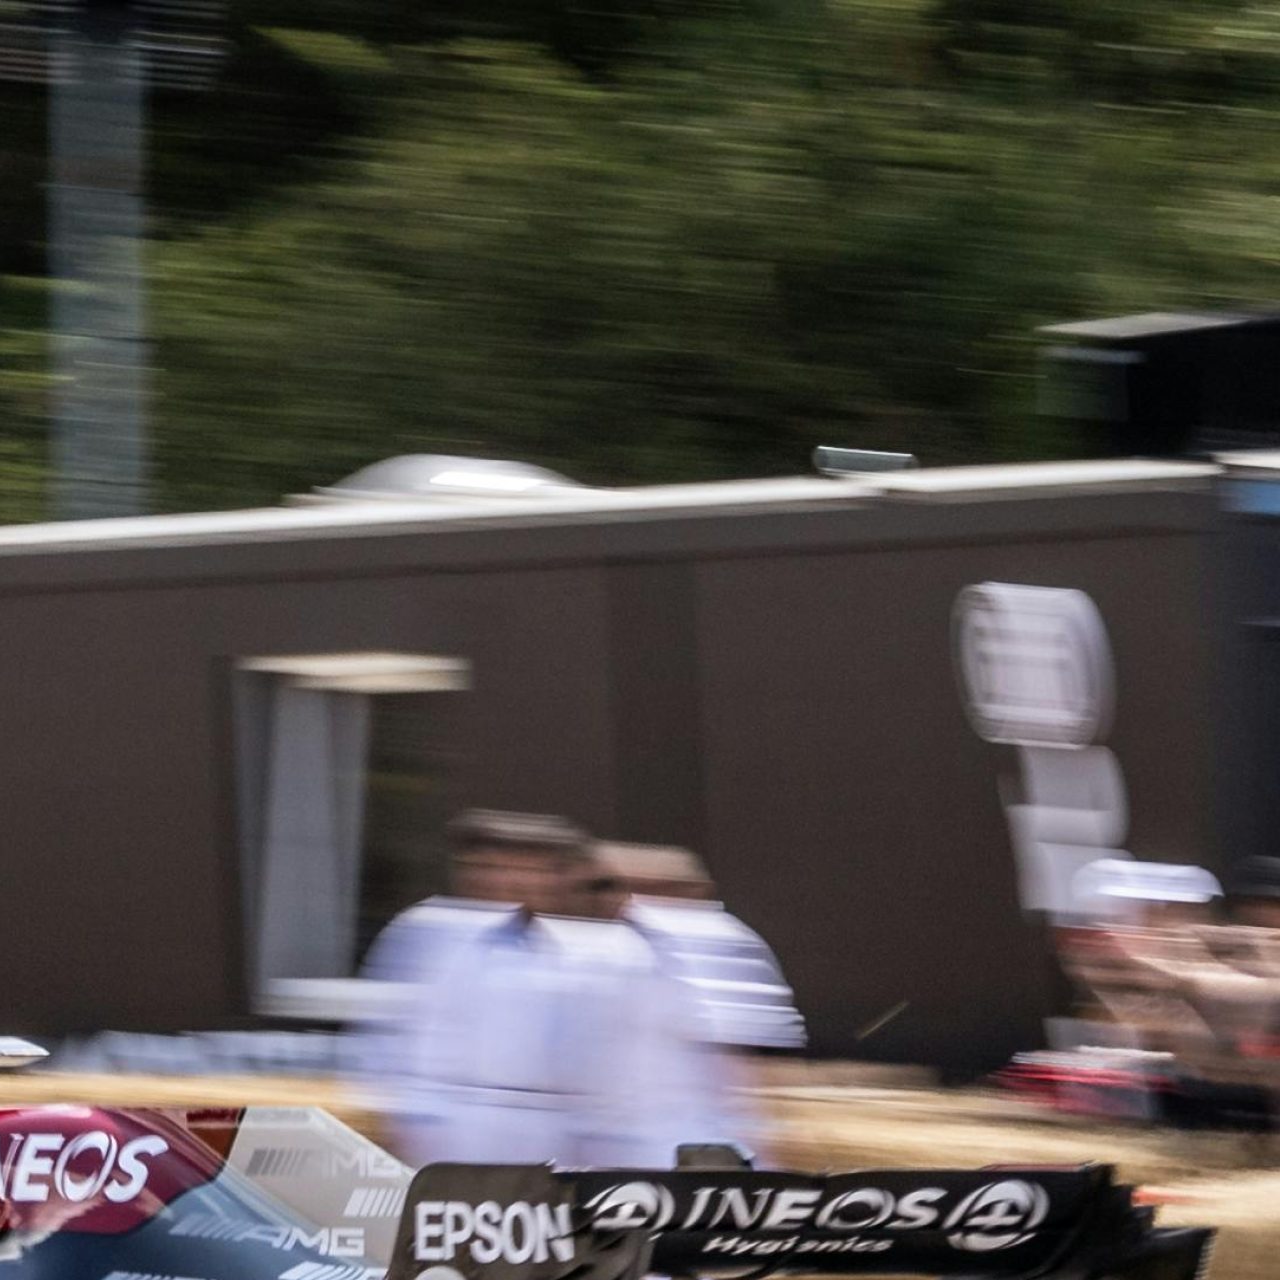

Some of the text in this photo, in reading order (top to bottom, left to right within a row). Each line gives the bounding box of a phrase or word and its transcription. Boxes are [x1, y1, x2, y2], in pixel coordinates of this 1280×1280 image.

[415, 1200, 575, 1264] EPSON
[681, 1186, 950, 1232] INEOS
[233, 1224, 366, 1258] AMG
